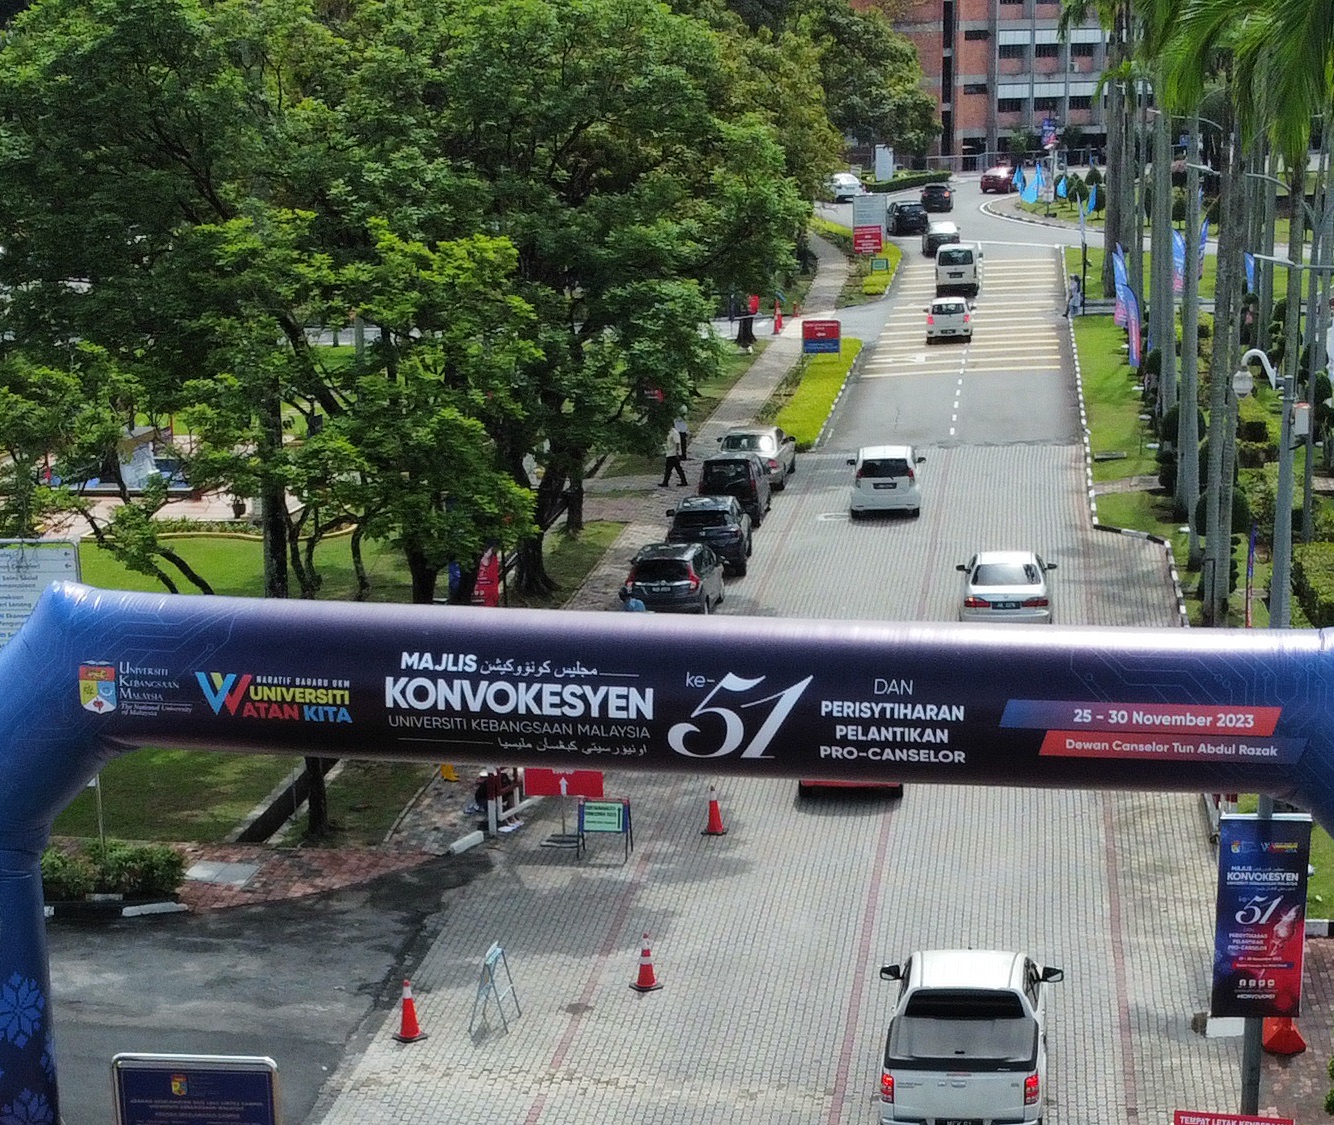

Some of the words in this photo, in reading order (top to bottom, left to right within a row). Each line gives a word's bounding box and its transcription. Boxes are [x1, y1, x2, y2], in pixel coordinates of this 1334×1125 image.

[400, 651, 478, 673] MAJLIS
[249, 685, 350, 705] UNIVERSITI
[873, 678, 914, 696] DAN
[385, 675, 654, 720] KONVOKESYEN
[303, 705, 353, 724] KITA
[820, 700, 965, 722] PERISYTIHARAN
[1073, 709, 1092, 723] 25
[1108, 710, 1129, 724] 30
[1132, 711, 1213, 727] November
[1216, 713, 1255, 728] 2023
[388, 714, 467, 731] UNIVERSITI
[471, 719, 574, 736] KEBANGSAAN
[577, 723, 651, 739] MALAYSIA
[835, 724, 949, 744] PELANTIKAN
[819, 745, 966, 764] PRO-CANSELOR
[1065, 738, 1109, 751] Dewan
[1112, 739, 1170, 753] Canselor
[1172, 742, 1194, 754] Tun
[1197, 743, 1236, 755] Abdul
[1238, 744, 1278, 757] Razak
[1226, 872, 1299, 881] KONVOKESYEN
[1179, 1115, 1211, 1125] TEMPAT
